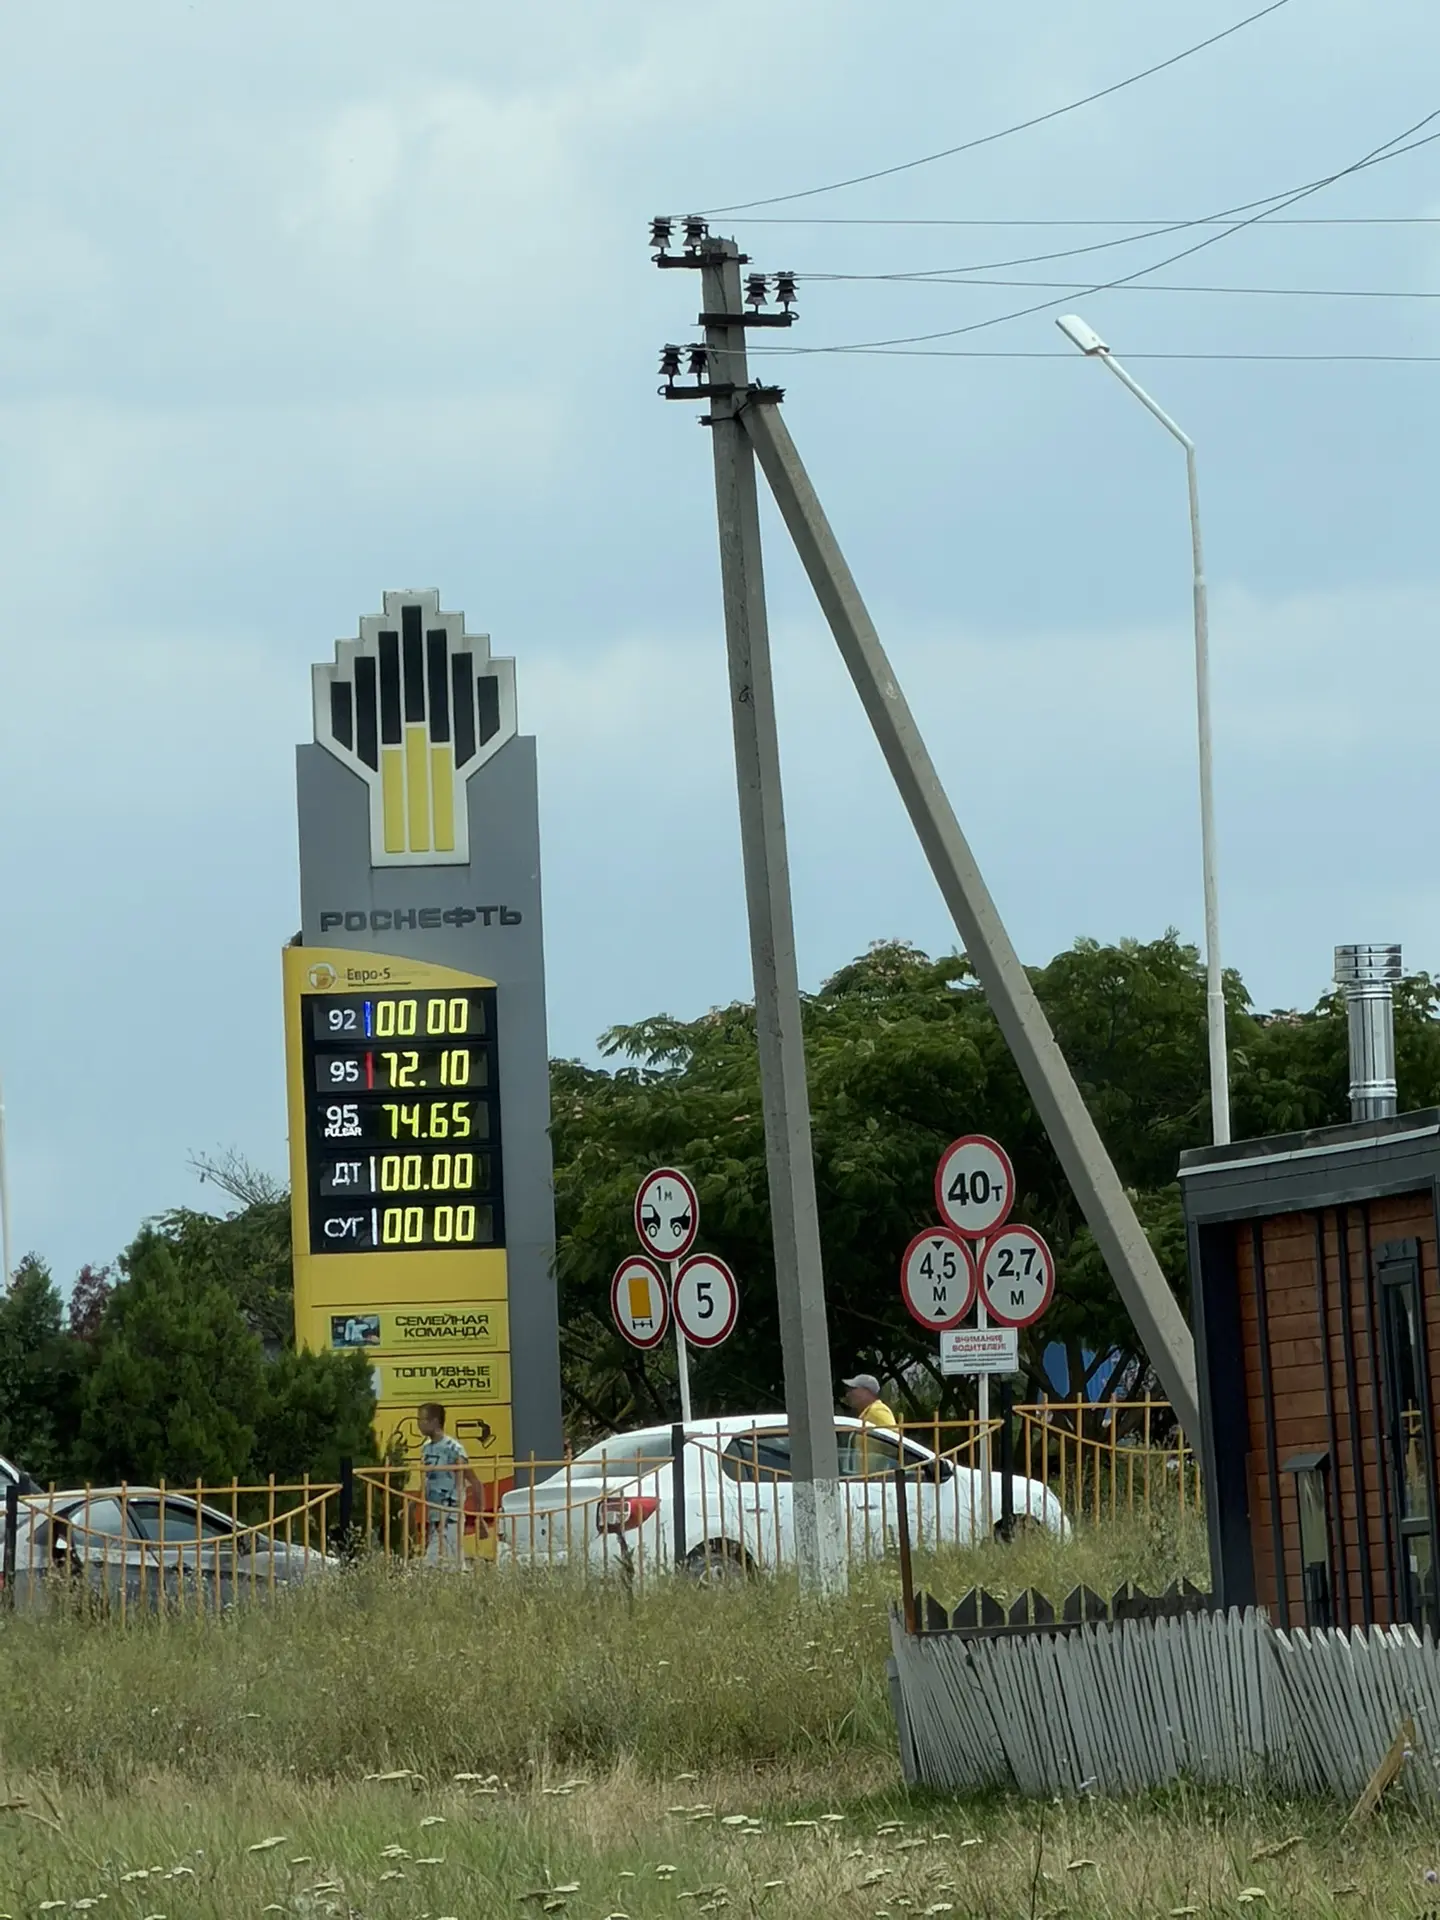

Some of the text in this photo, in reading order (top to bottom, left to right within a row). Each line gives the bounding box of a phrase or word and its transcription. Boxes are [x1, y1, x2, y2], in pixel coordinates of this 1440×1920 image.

[320, 905, 522, 932] РОСНЕФТЬ
[346, 967, 391, 983] Евро-5
[328, 1009, 357, 1031] 92
[330, 1061, 359, 1082] 95
[326, 1101, 471, 1139] 95 74.65
[324, 1127, 363, 1138] PULSAR
[332, 1153, 473, 1191] ДТ 00.00
[324, 1217, 364, 1238] СУГ
[919, 1252, 956, 1284] 4,5
[997, 1248, 1036, 1281] 2,7
[696, 1282, 714, 1319] 5
[395, 1314, 489, 1327] СЕМЕЙНАЯ
[404, 1326, 489, 1339] КОМАНДА
[392, 1366, 490, 1378] ТОПЛИВНЫЕ
[435, 1378, 491, 1390] КАРТЫ
